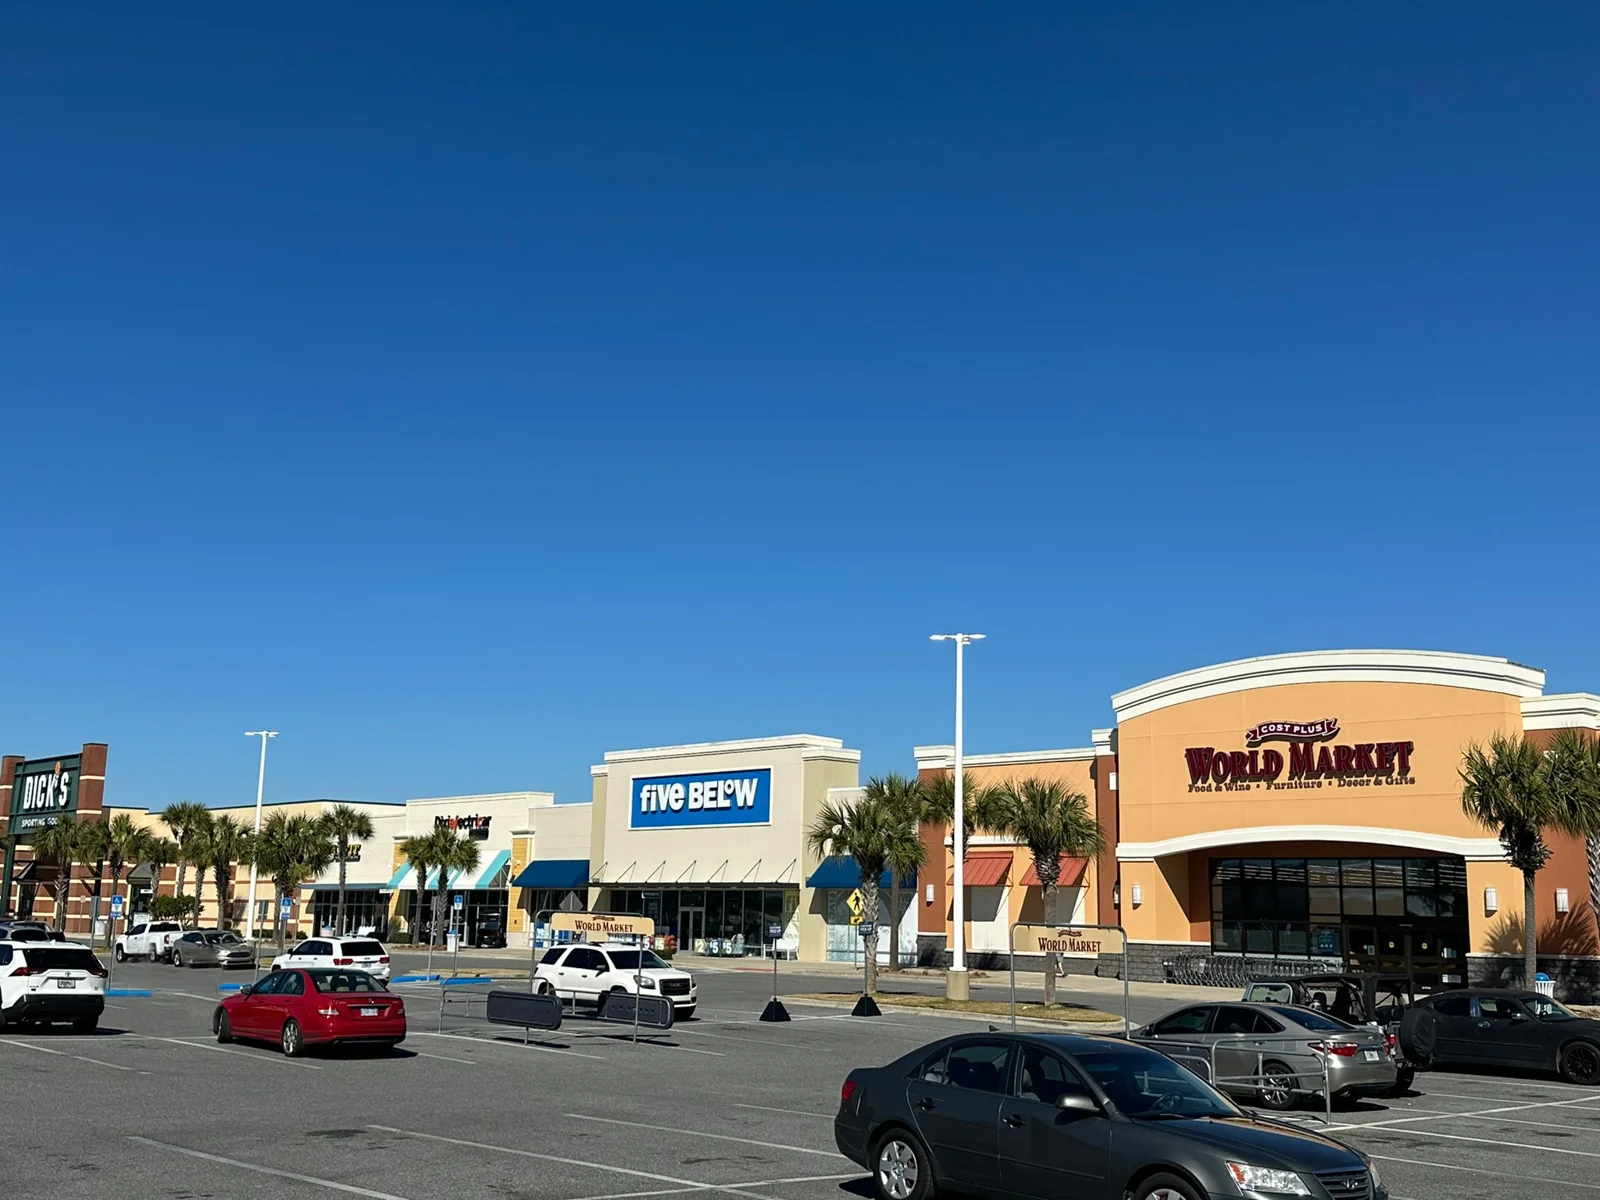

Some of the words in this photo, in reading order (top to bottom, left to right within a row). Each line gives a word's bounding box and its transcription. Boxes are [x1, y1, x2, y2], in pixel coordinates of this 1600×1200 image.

[1261, 724, 1290, 733] COST
[1293, 723, 1322, 733] PLUS
[1185, 747, 1284, 783] WORLD
[1288, 740, 1414, 780] MARKET
[23, 772, 69, 809] DICK'S
[1188, 784, 1212, 792] Food
[1215, 783, 1222, 791] &
[1224, 783, 1250, 791] Wine
[1266, 780, 1322, 790] Furniture
[1337, 778, 1371, 787] Decor
[1374, 778, 1382, 786] &
[1385, 776, 1415, 785] Gifts
[22, 819, 46, 828] SPORTING
[574, 920, 601, 932] WORLD
[602, 921, 633, 933] MARKET
[1038, 937, 1067, 951] WORLD
[1069, 938, 1101, 952] MARKET
